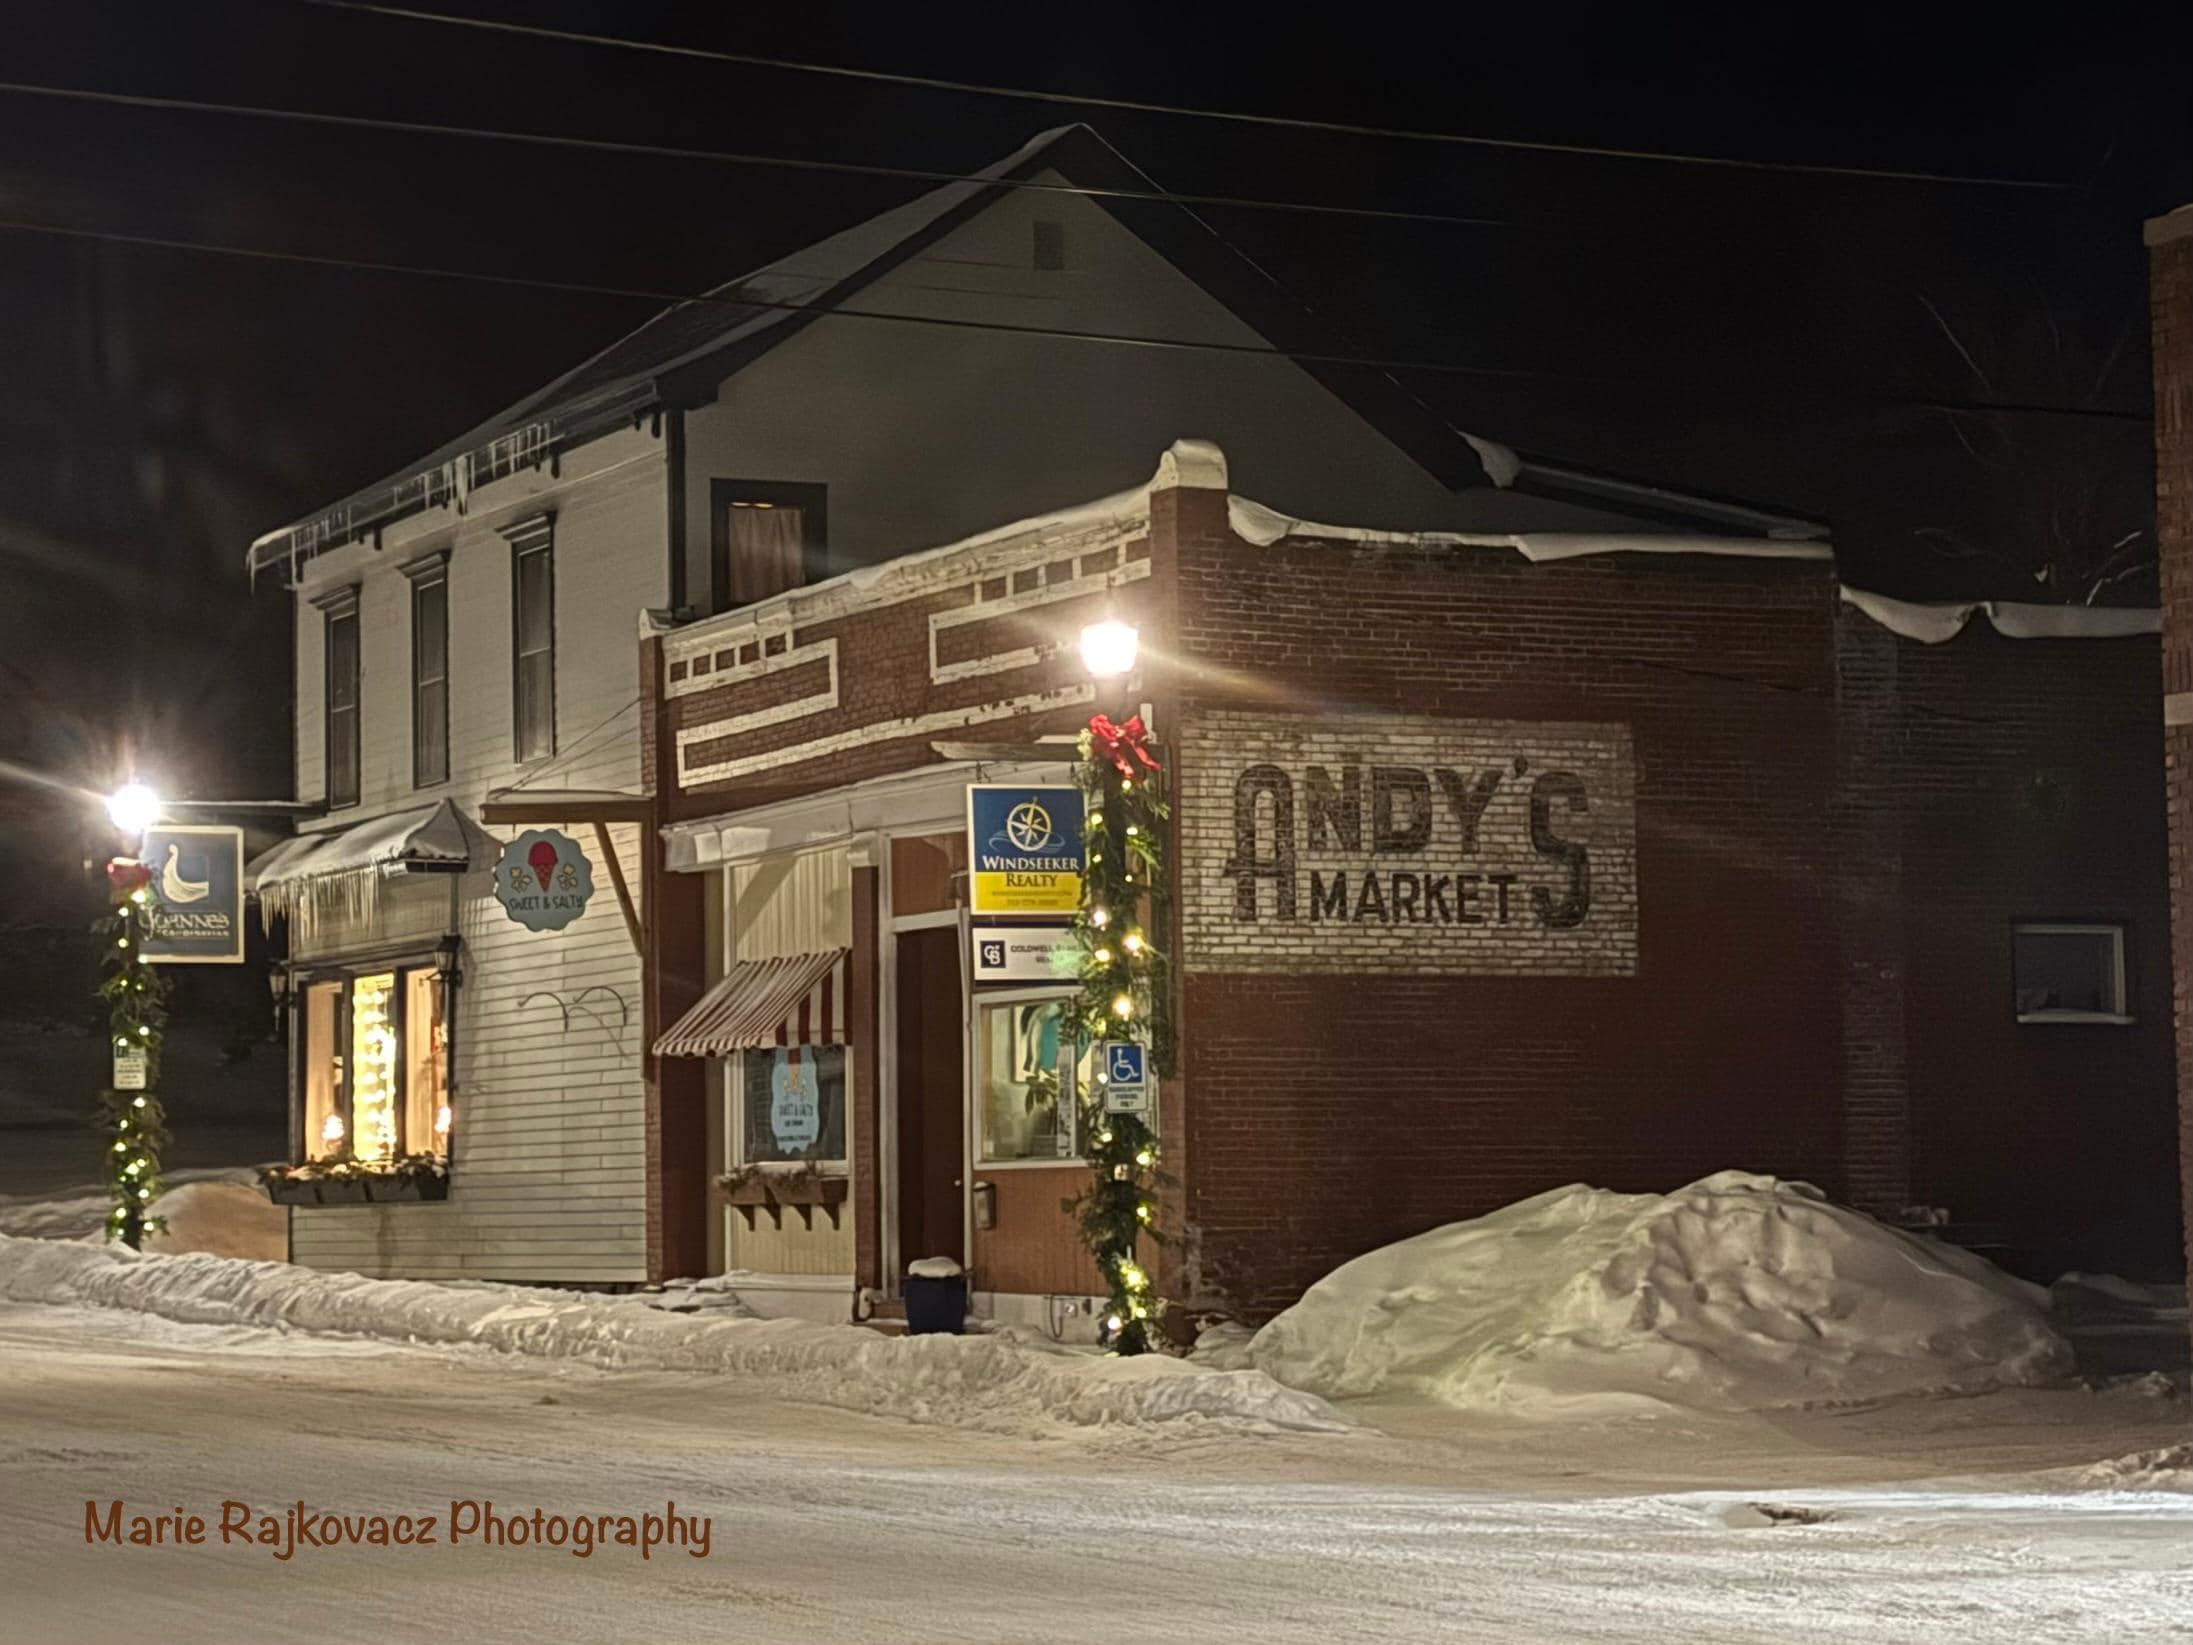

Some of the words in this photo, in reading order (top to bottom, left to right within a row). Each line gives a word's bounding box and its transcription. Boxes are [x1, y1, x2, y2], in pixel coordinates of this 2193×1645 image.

[1223, 757, 1590, 928] ANDY'S
[982, 855, 1079, 870] WINDSEEKER
[1006, 873, 1057, 887] REALTY
[1310, 870, 1517, 924] MARKET
